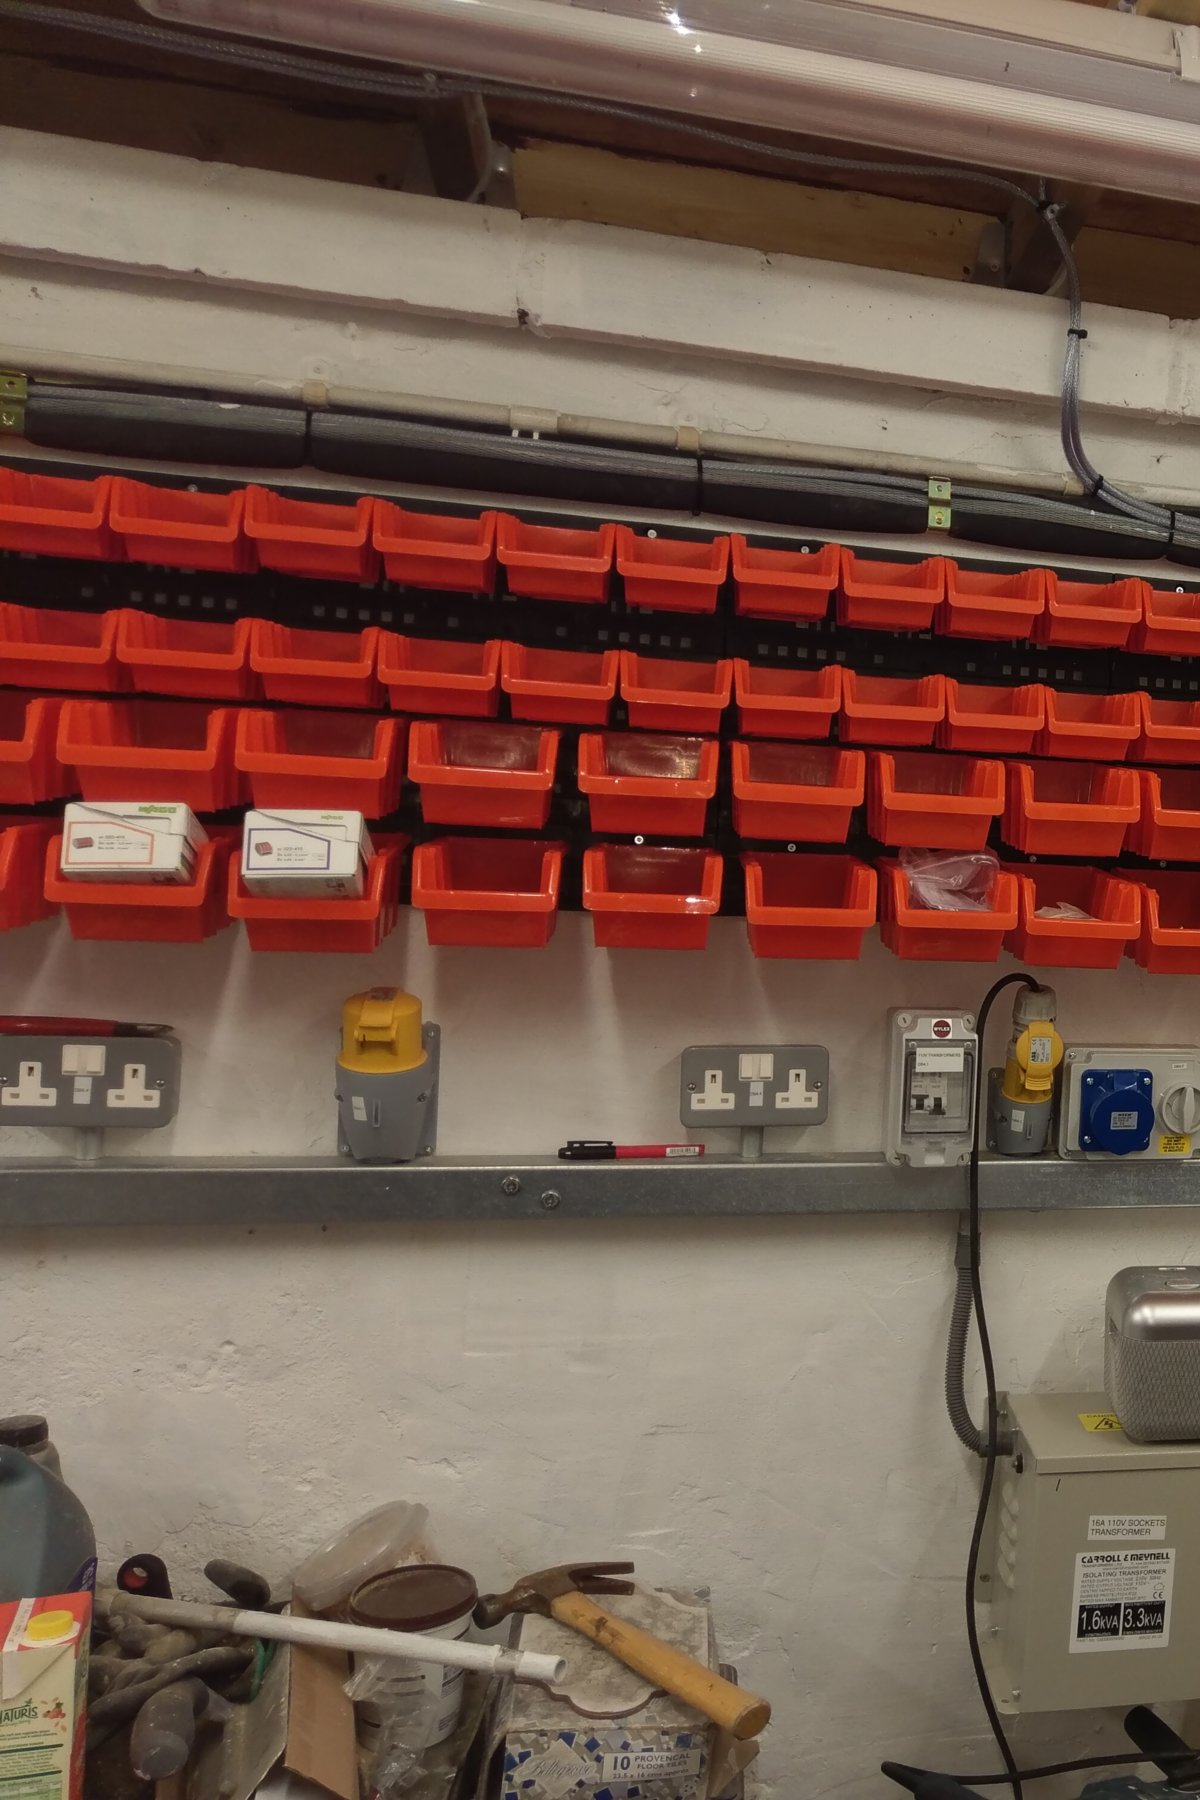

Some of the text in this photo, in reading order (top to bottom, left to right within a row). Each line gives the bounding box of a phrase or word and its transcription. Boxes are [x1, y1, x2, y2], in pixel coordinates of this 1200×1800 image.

[1082, 1555, 1121, 1564] CARROLL
[1130, 1552, 1170, 1561] MEYNELL
[1081, 1608, 1162, 1630] 1.6kVA 3.3kVA
[612, 1756, 631, 1771] 10
[635, 1753, 691, 1763] PROVENCAL
